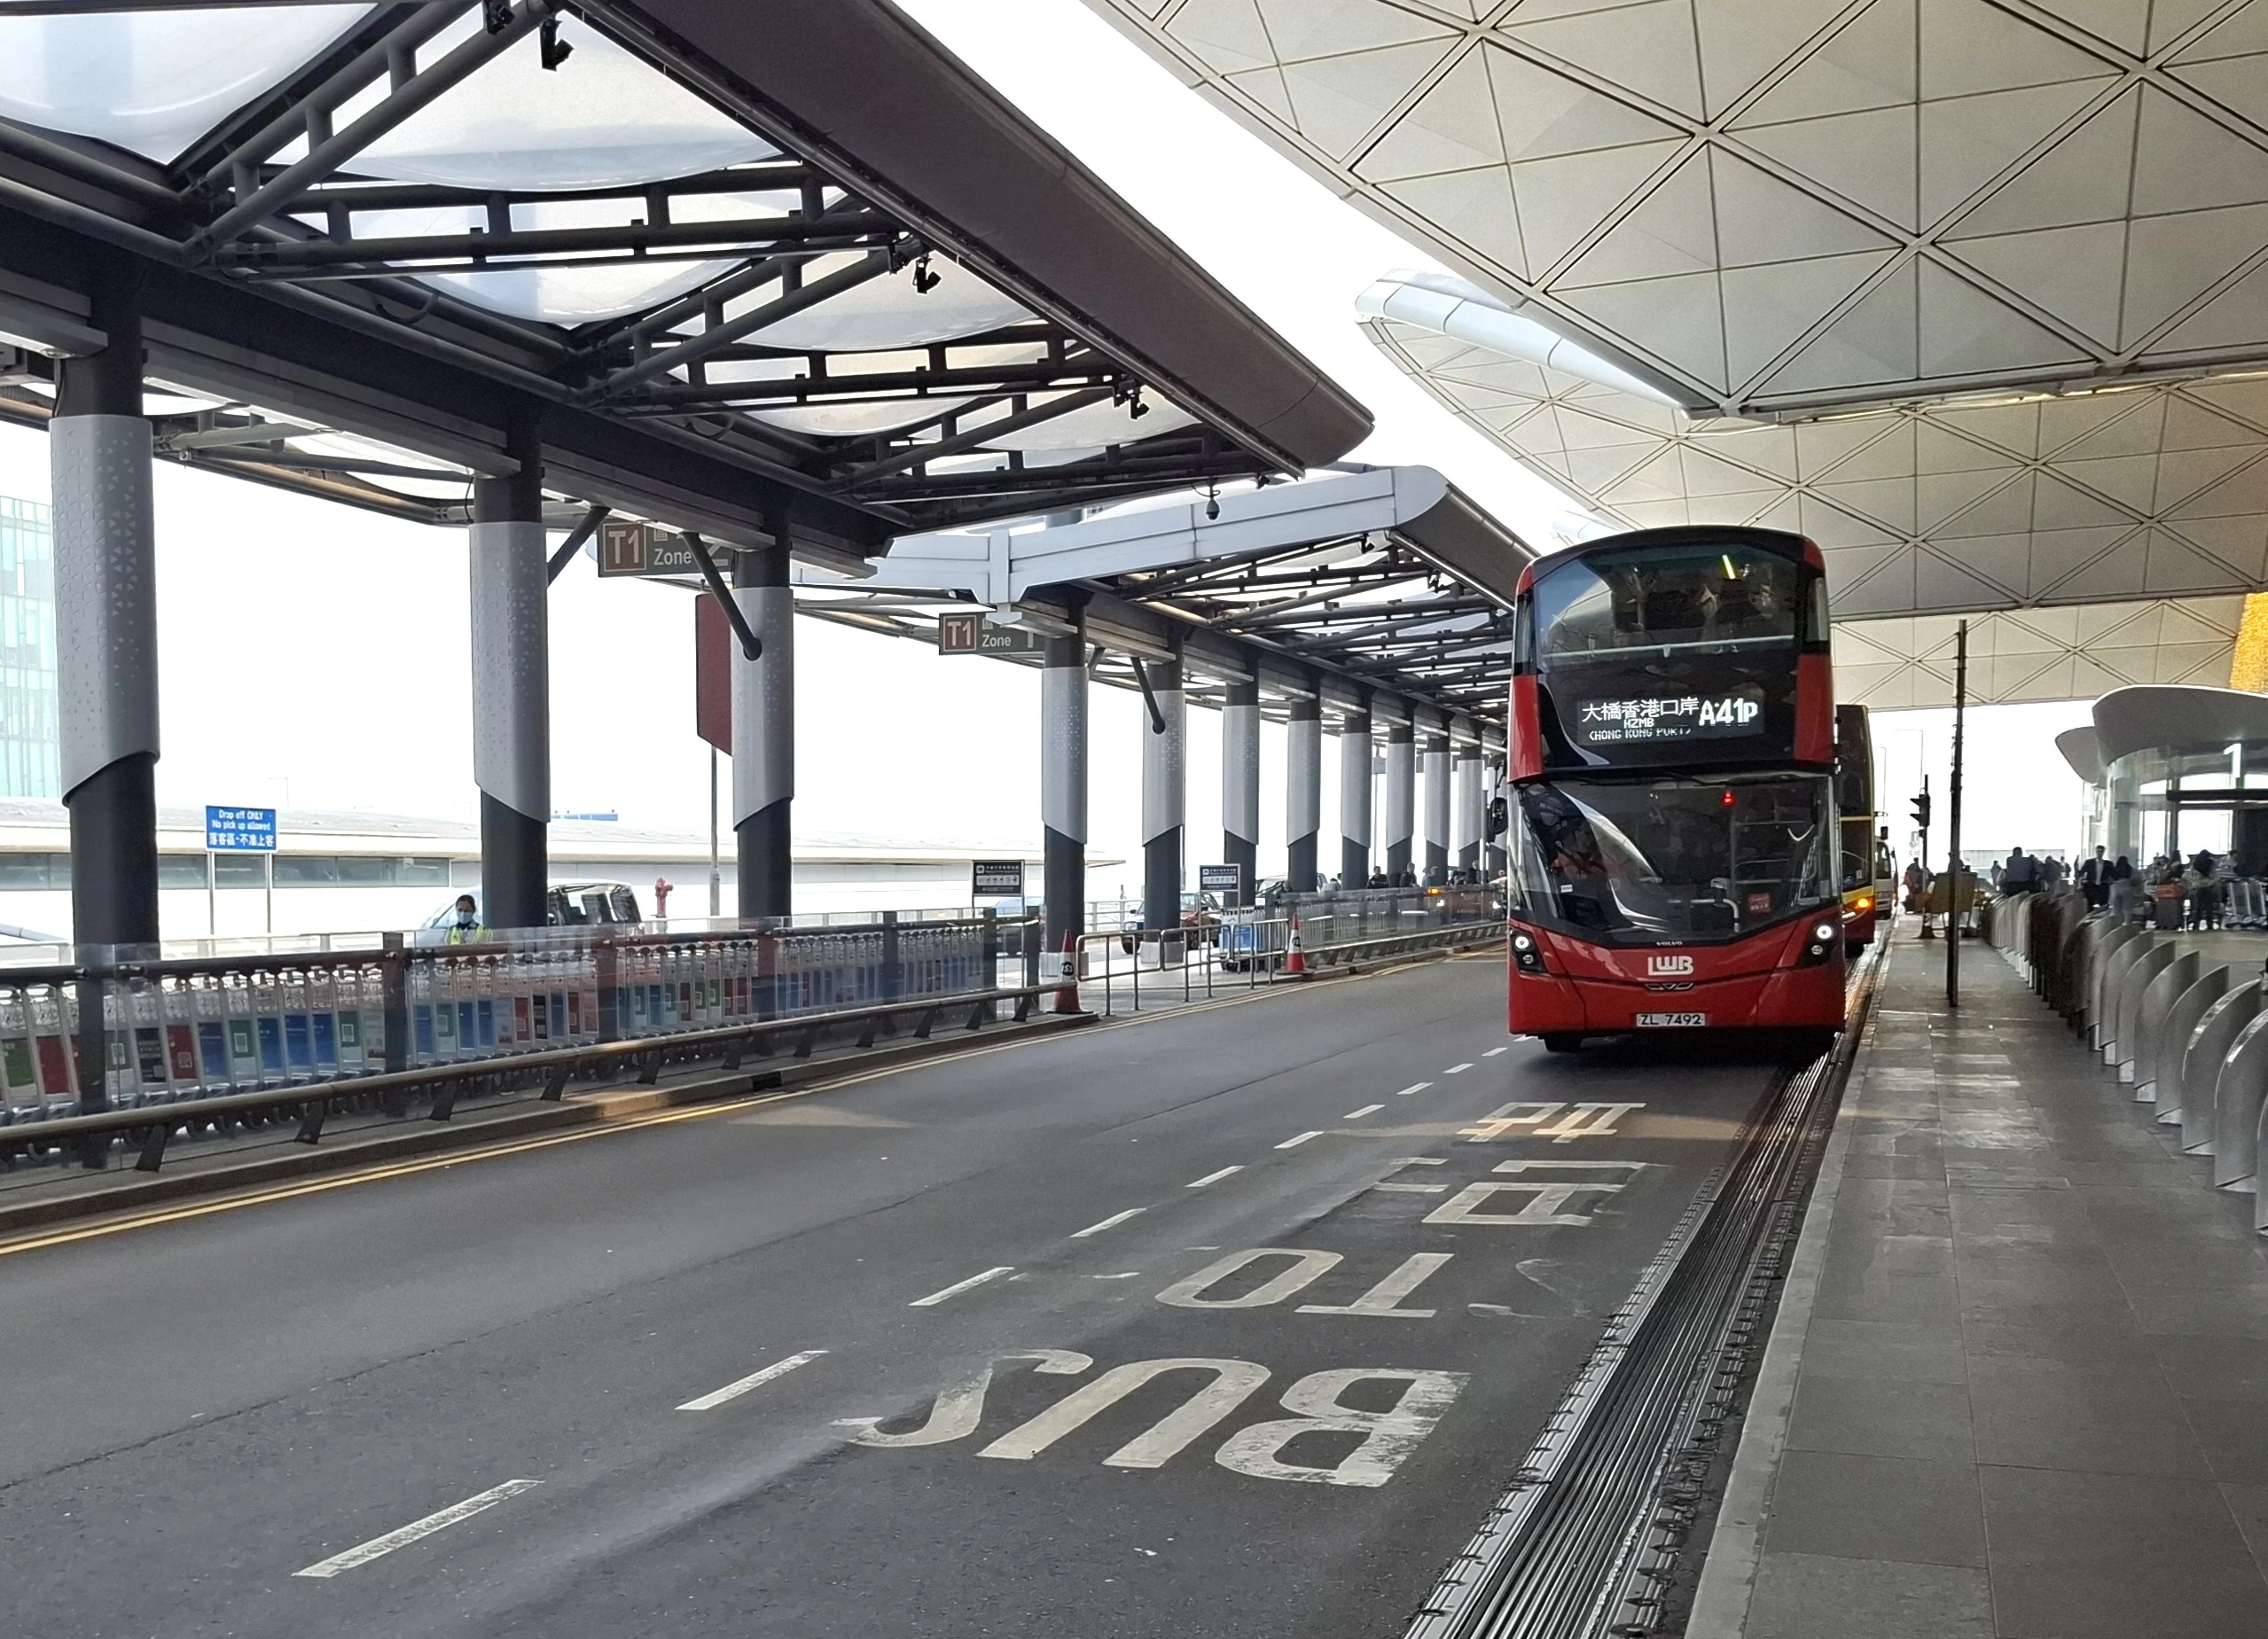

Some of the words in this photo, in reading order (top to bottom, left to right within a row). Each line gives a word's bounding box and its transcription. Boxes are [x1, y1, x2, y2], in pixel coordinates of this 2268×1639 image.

[608, 529, 639, 565] T1
[653, 548, 692, 566] Zone
[947, 620, 972, 646] T1
[981, 634, 1012, 648] Zone
[1582, 697, 1700, 722] 大橋香港口岸
[1698, 698, 1759, 727] A41P
[1623, 717, 1654, 729] HZMB
[2223, 743, 2241, 778] 1
[211, 820, 222, 829] No
[223, 821, 236, 830] pick
[218, 809, 234, 820] Drop
[247, 811, 263, 820] ONLY
[1647, 955, 1694, 976] LWB
[1639, 1014, 1660, 1026] ZL
[1665, 1014, 1701, 1026] 7492
[831, 1348, 1472, 1487] BUS
